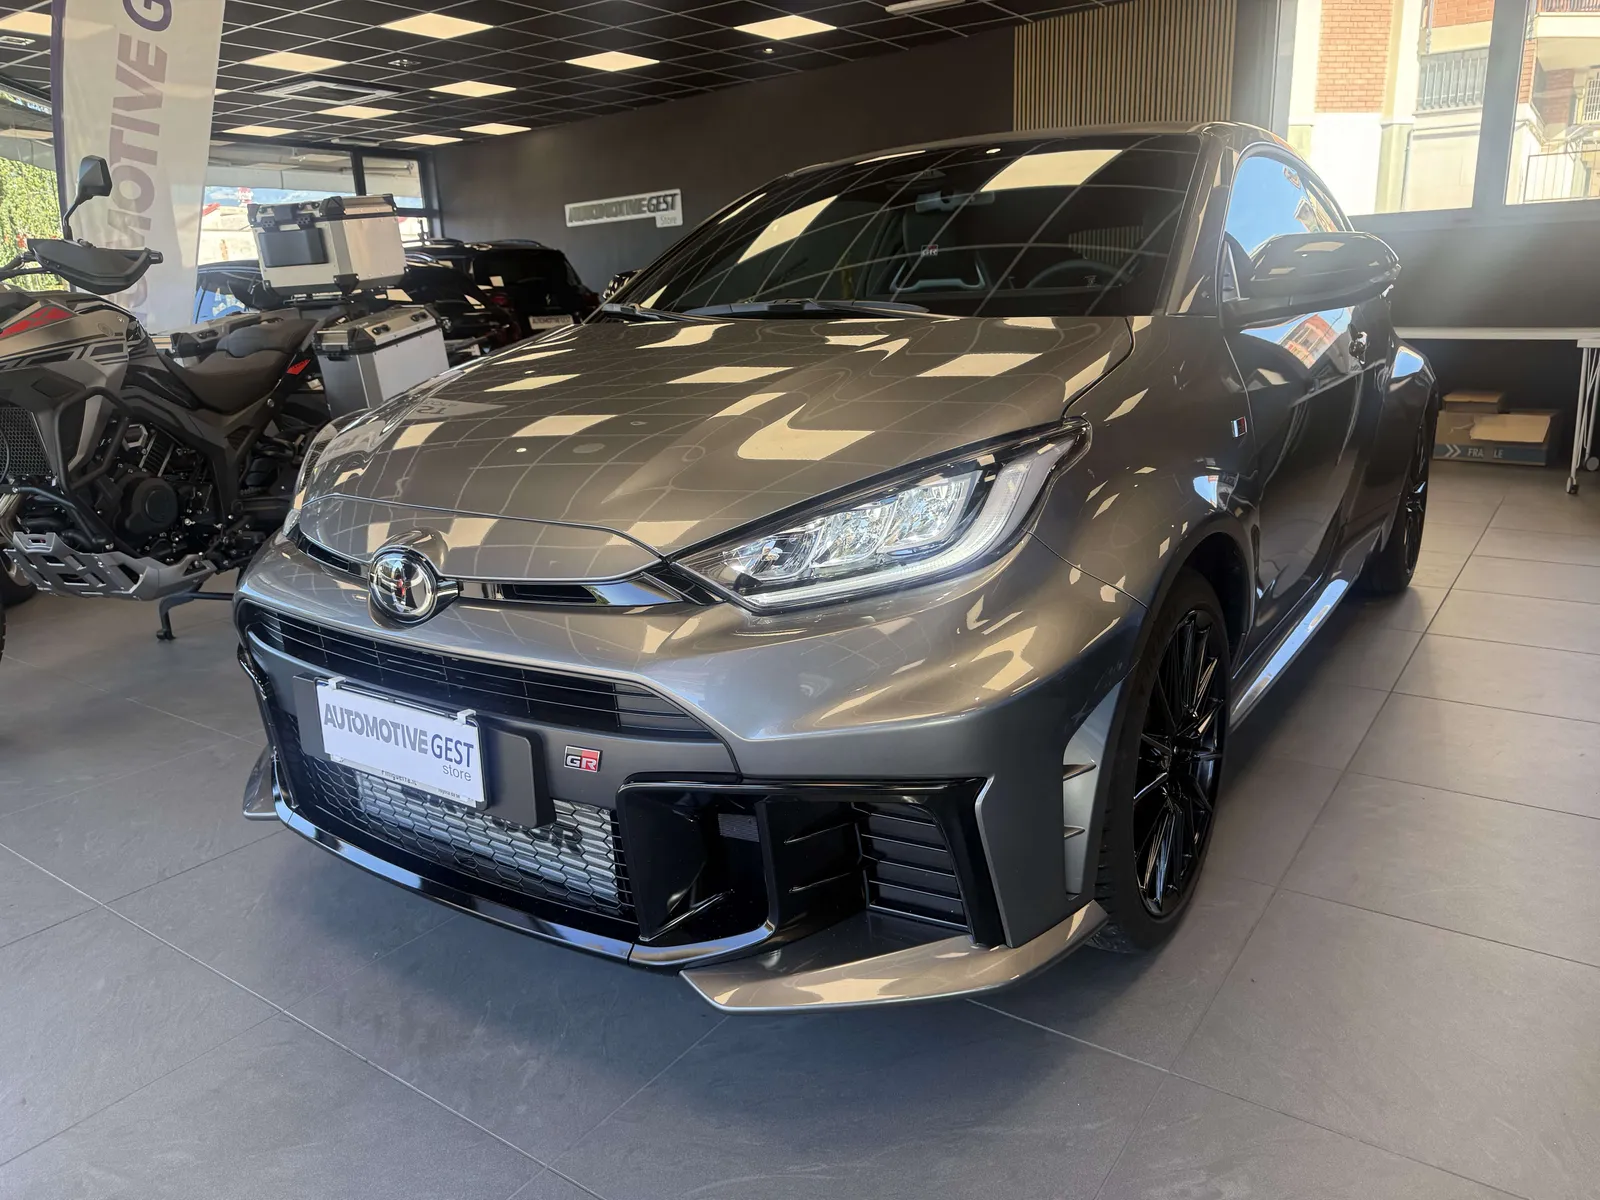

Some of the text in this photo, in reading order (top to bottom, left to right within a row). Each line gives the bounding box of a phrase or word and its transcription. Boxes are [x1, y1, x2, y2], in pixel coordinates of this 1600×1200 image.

[1467, 447, 1504, 459] FRALE
[324, 703, 474, 768] AUTOMOTIVE GEST
[566, 755, 598, 771] GR
[442, 763, 473, 783] store
